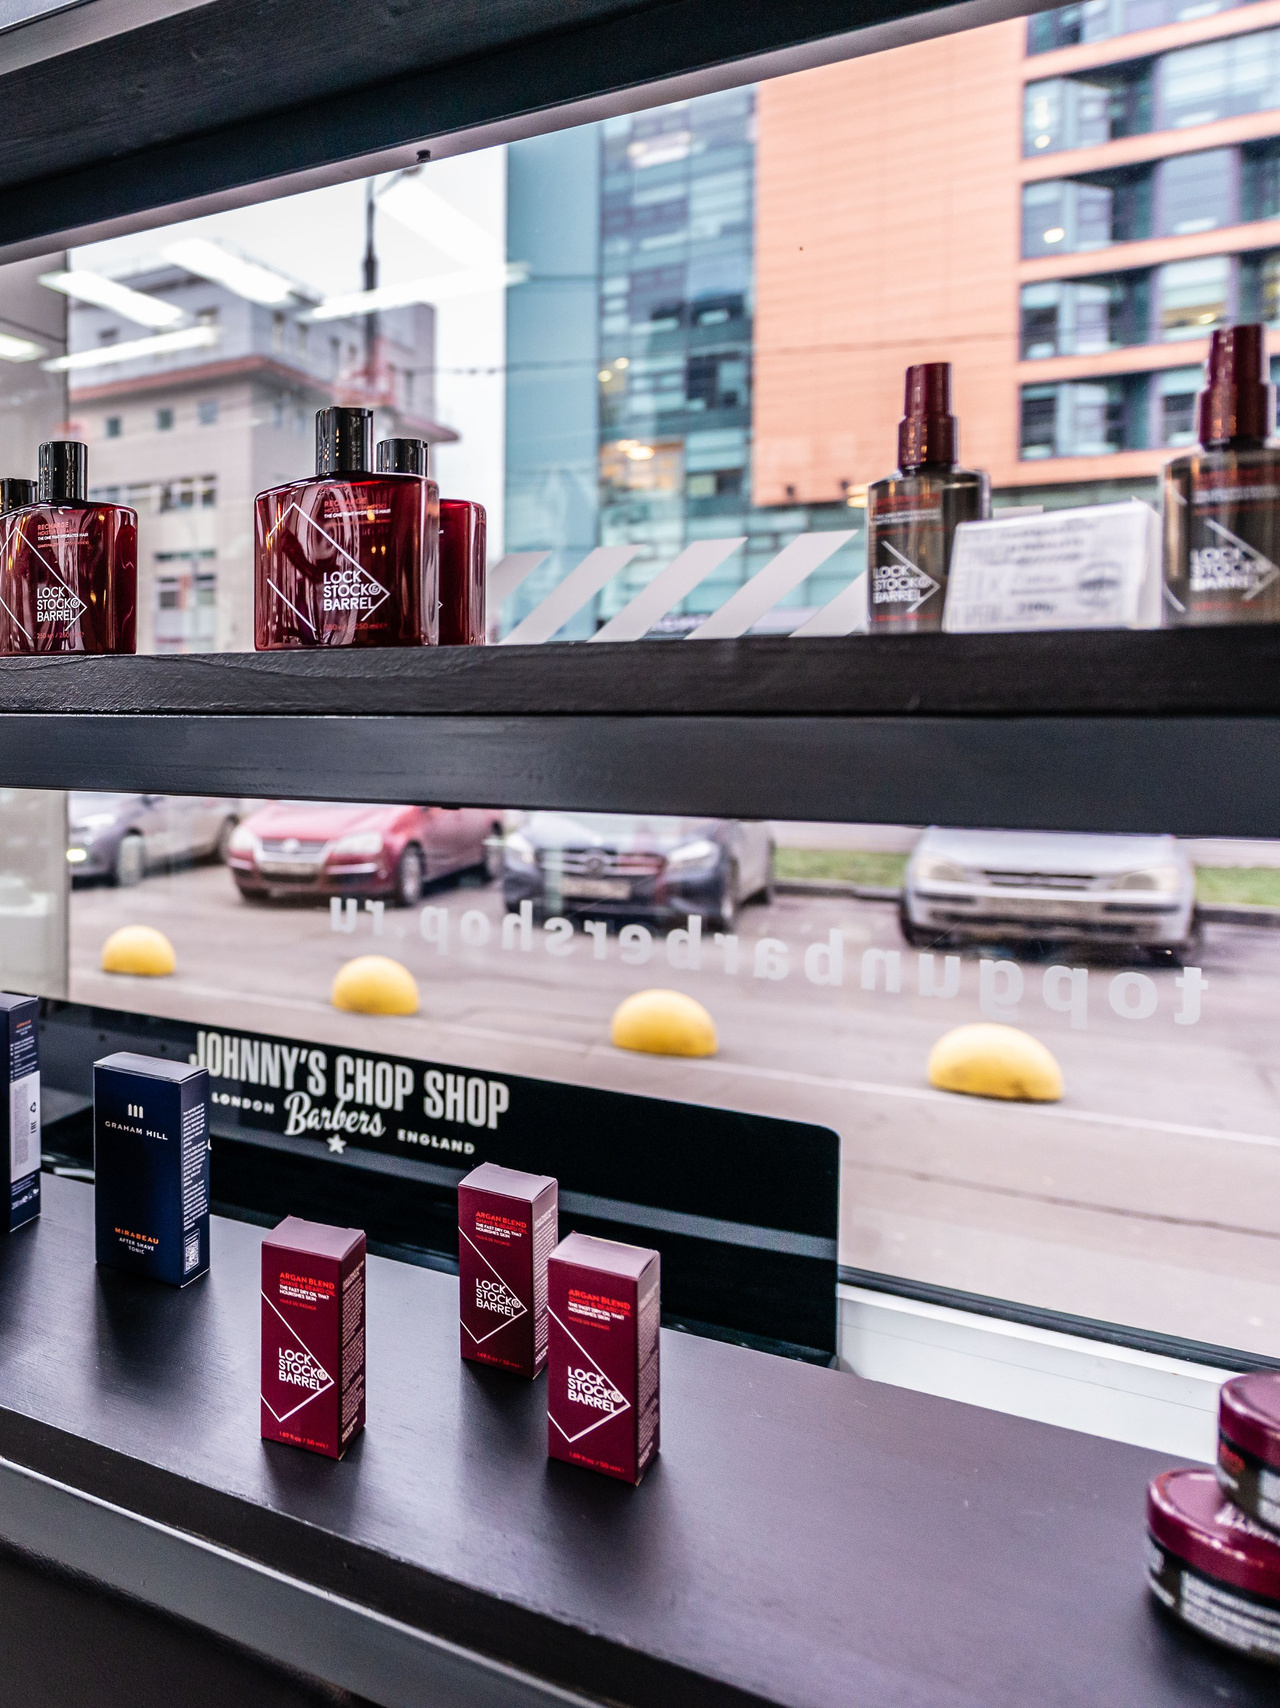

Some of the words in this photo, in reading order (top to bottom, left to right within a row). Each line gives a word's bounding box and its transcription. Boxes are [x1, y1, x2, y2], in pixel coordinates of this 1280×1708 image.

[37, 521, 69, 531] RECHARGE
[323, 570, 361, 585] LOCK
[872, 565, 910, 579] LOCK
[36, 586, 65, 598] LOCK
[872, 589, 923, 604] BARREL
[323, 596, 376, 611] BARREL
[36, 609, 76, 622] BARREL
[189, 1030, 327, 1097] JOHNNY'S
[334, 1054, 415, 1112] CHOP
[423, 1069, 510, 1130] SHOP
[211, 1091, 275, 1115] LONDON
[283, 1091, 387, 1138] Barbers
[104, 1120, 143, 1135] GRAHAM
[146, 1129, 169, 1141] HILL
[397, 1128, 476, 1156] ENGLAND
[476, 1211, 501, 1222] ARGAN
[502, 1217, 527, 1229] BLEND
[114, 1227, 160, 1245] MIRABEAU
[119, 1237, 136, 1247] AFTER
[136, 1240, 155, 1252] SHAVE
[128, 1245, 145, 1255] TONIC
[279, 1272, 308, 1284] ARGAN
[308, 1277, 335, 1290] BLEND
[476, 1278, 506, 1296] LOCK
[476, 1298, 517, 1318] BARREL
[568, 1289, 600, 1302] ARGAN
[600, 1296, 631, 1310] BLEND
[279, 1347, 311, 1366] LOCK
[279, 1370, 322, 1391] BARREL
[568, 1366, 604, 1387] LOCK
[568, 1389, 617, 1413] BARREL
